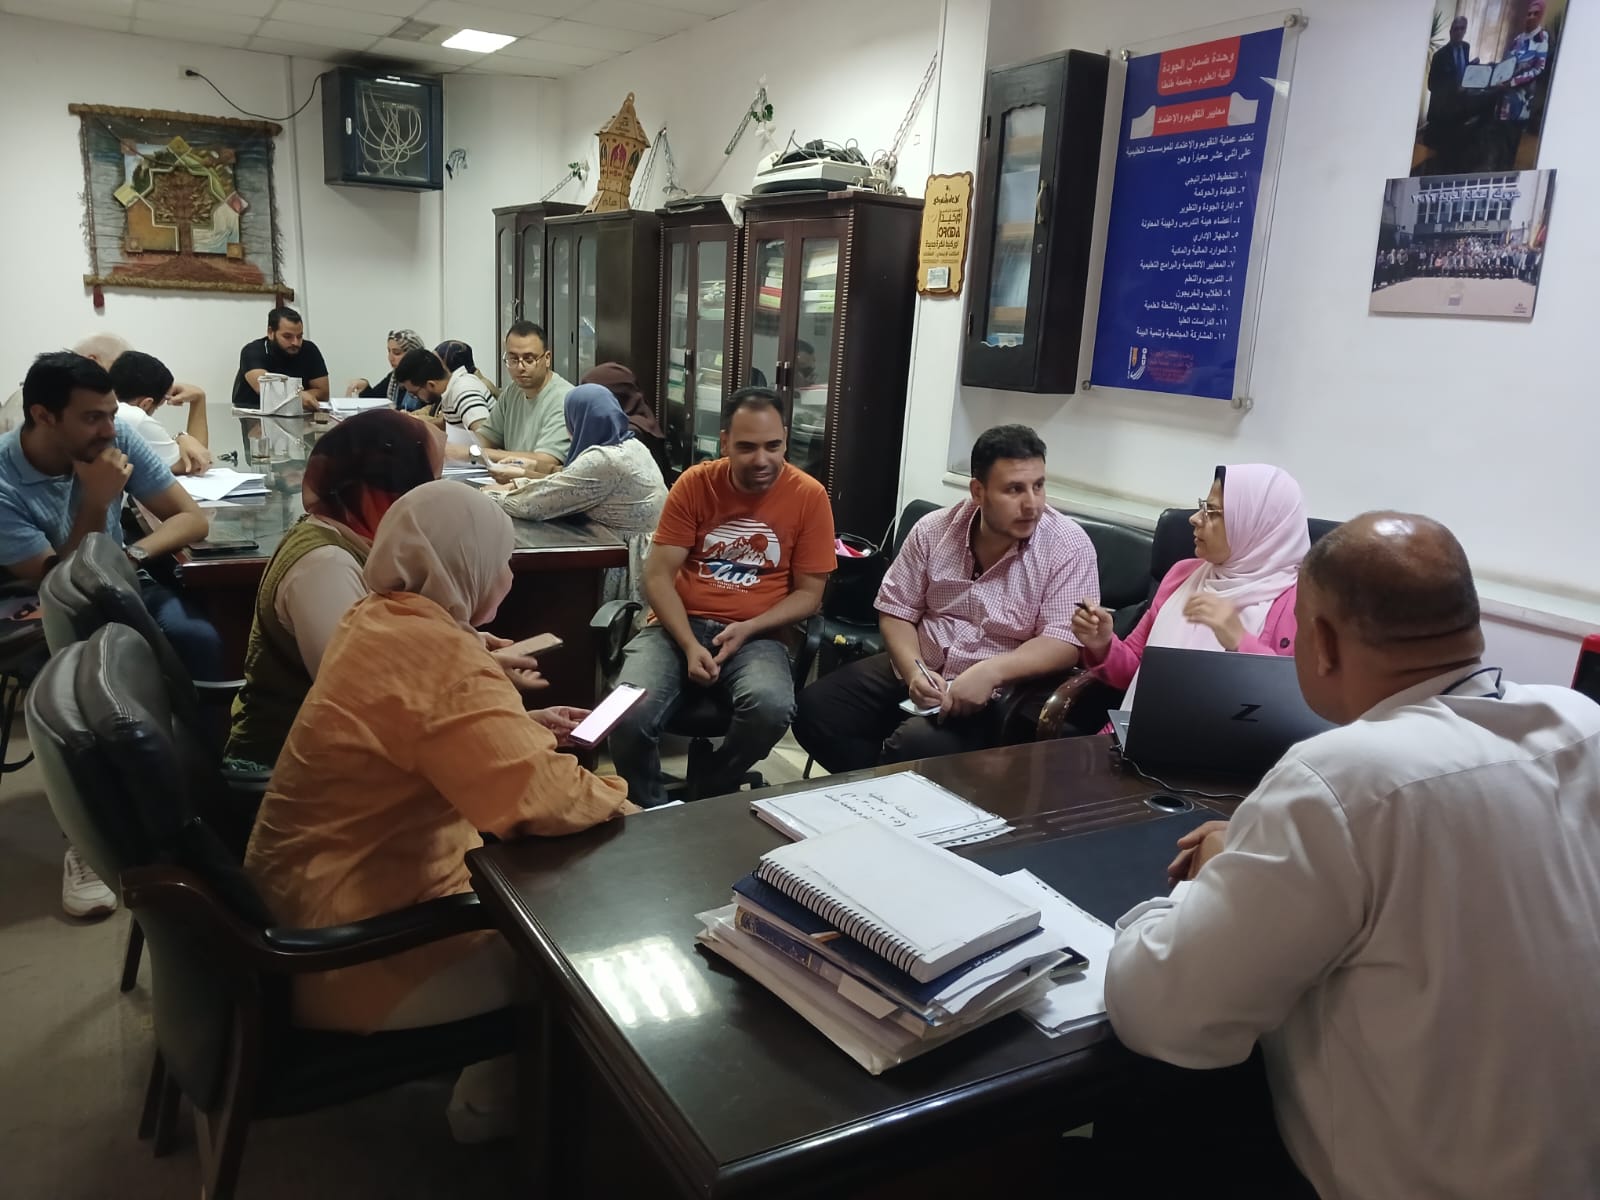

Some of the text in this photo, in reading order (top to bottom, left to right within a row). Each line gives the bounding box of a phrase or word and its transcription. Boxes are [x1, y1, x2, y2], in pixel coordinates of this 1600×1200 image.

[1161, 52, 1235, 75] وحدة ضمان الجودة
[1198, 71, 1217, 84] العلوم
[1217, 69, 1231, 80] كلية
[1161, 78, 1175, 89] طنطا
[1184, 108, 1205, 123] التقويم
[1206, 107, 1226, 119] معايير
[1199, 136, 1218, 149] التقويم
[1219, 133, 1236, 146] عملية
[1238, 132, 1255, 143] تعتمد
[1216, 171, 1239, 182] التخطيط
[1193, 188, 1219, 198] والحوكمة
[1219, 186, 1237, 196] القيادة
[1179, 203, 1202, 214] والتطوير
[1202, 202, 1220, 212] الجودة
[1160, 217, 1178, 229] والهيئة
[1178, 217, 1200, 228] التدريس
[1212, 231, 1231, 241] الجهاز
[1191, 244, 1208, 255] المالية
[1209, 244, 1228, 255] الموارد
[1159, 260, 1181, 271] والبرامج
[1202, 274, 1224, 284] التدريس
[1175, 289, 1204, 298] والخريجون
[1205, 288, 1223, 298] الطلاب
[1200, 303, 1217, 313] البحث
[1178, 316, 1191, 326] العليا
[1191, 316, 1215, 327] الدراسات
[1136, 326, 1149, 336] البيئة
[1149, 327, 1166, 338] وتنمية
[1166, 328, 1189, 339] المجتمعية
[1189, 330, 1214, 341] المشاركة
[1230, 703, 1263, 723] Z
